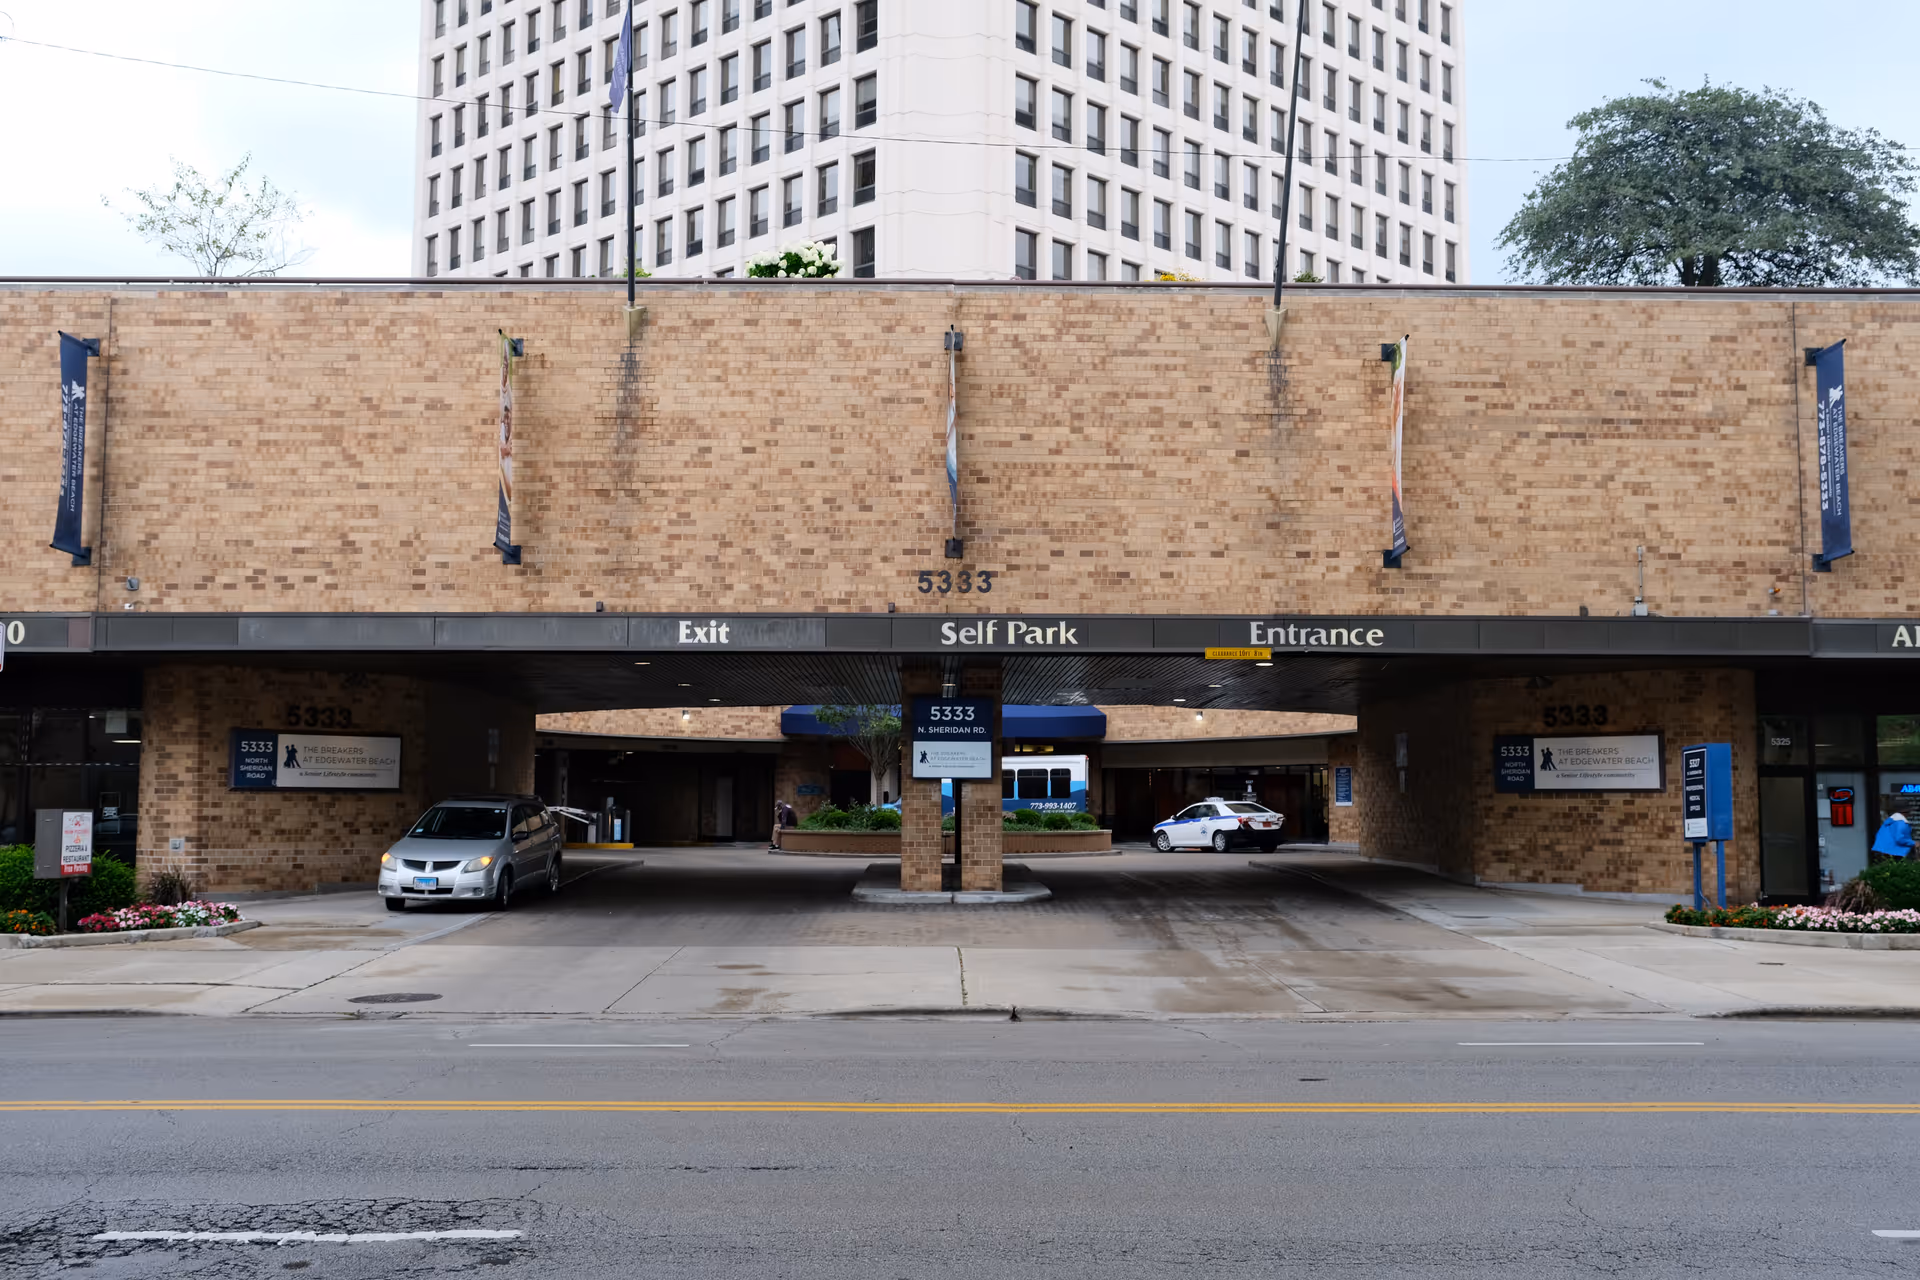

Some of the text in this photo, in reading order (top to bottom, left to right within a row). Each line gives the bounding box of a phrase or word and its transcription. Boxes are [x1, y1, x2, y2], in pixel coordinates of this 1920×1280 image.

[1818, 400, 1828, 511] 773-878-5333
[918, 570, 992, 594] 5333
[678, 620, 730, 644] Exit
[941, 619, 1080, 646] Self Park
[1250, 621, 1384, 646] Entrance
[288, 706, 352, 728] 5333
[930, 706, 975, 720] 5333
[1544, 704, 1608, 728] 5333
[241, 741, 273, 752] 5333
[303, 746, 364, 755] THE BREAKERS
[1501, 746, 1530, 756] 5333
[1576, 748, 1619, 756] BREAKERS
[316, 757, 368, 765] EDGEWATER
[369, 758, 396, 766] BEACH
[1570, 758, 1623, 766] EDGEWATER
[1625, 756, 1654, 764] BEACH
[63, 854, 90, 862] RESTAURANT
[74, 863, 88, 872] Parking
